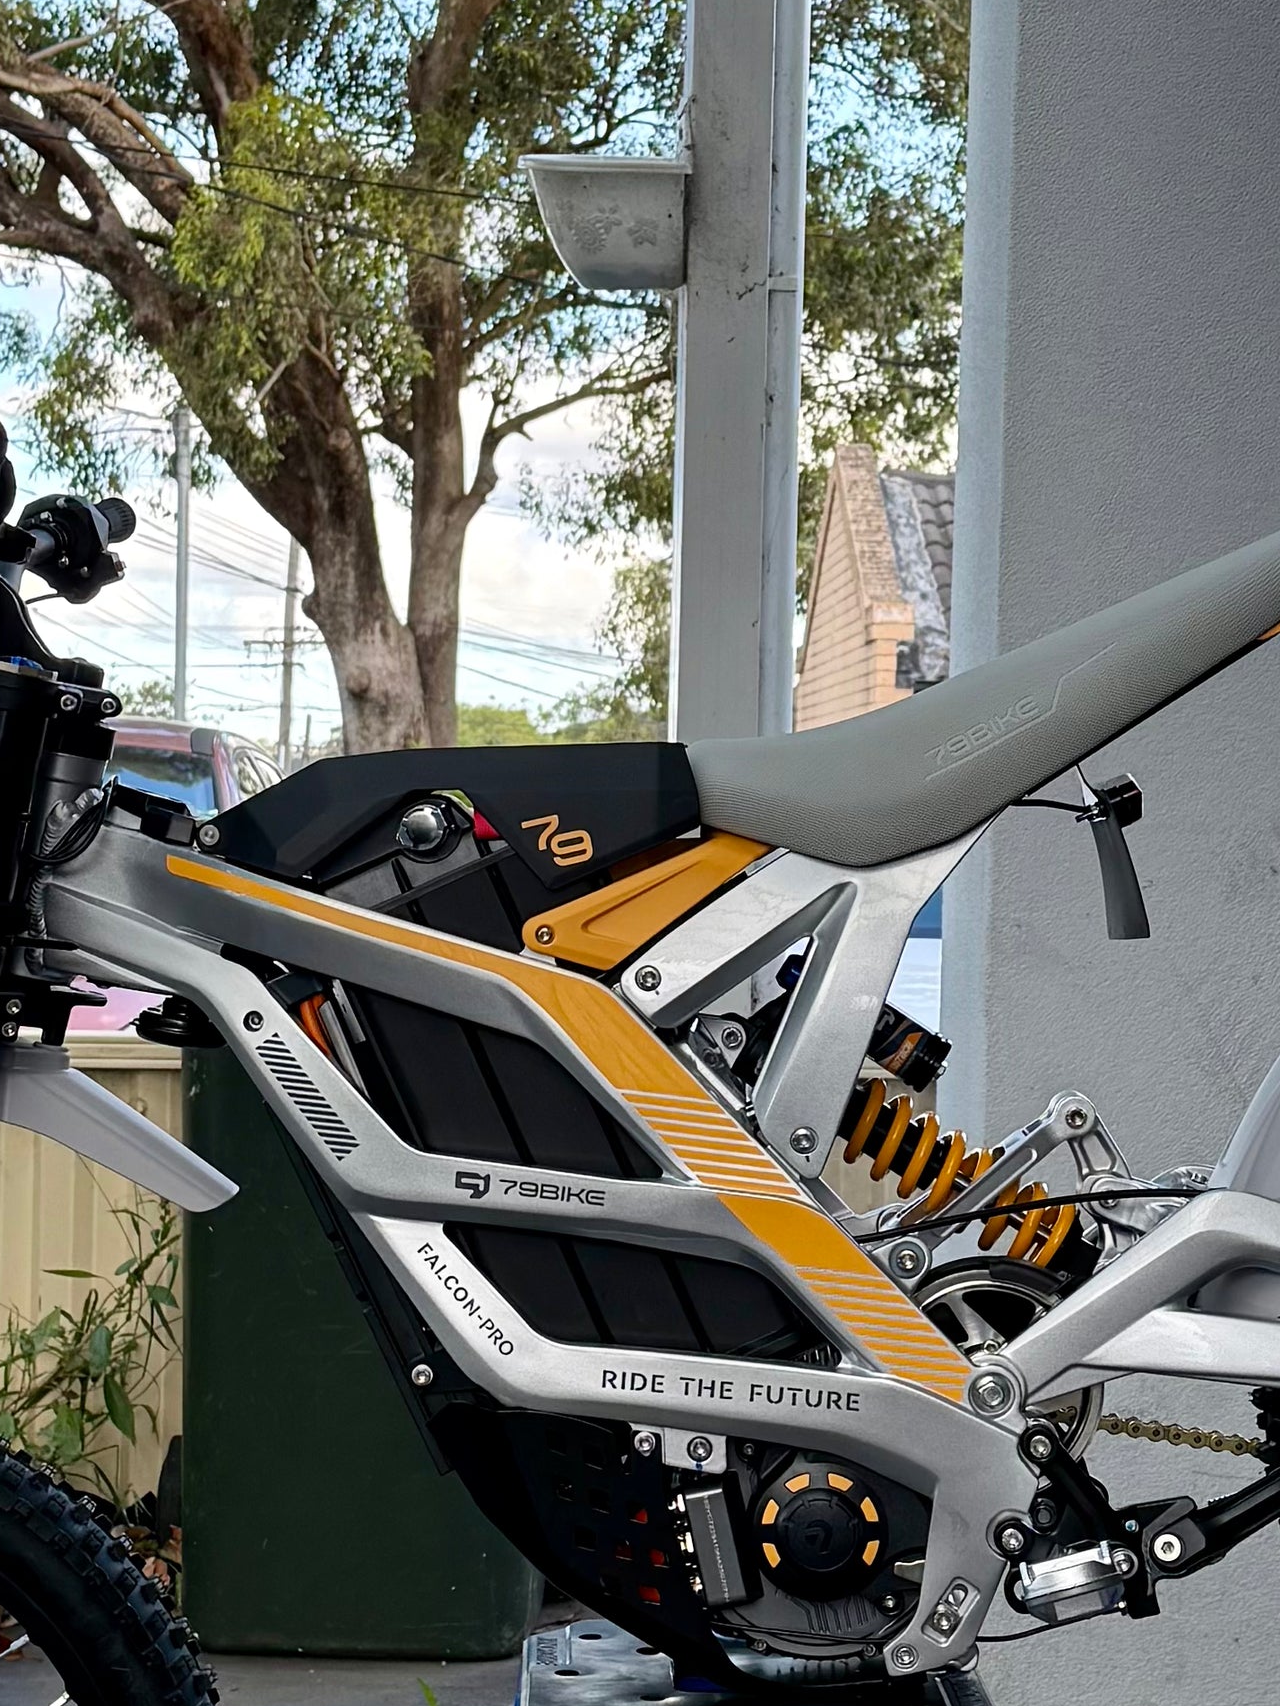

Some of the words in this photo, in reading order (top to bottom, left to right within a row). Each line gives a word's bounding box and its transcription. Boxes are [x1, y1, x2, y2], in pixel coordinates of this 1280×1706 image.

[924, 694, 1040, 765] 79BIKE
[521, 814, 594, 866] 79
[498, 1179, 607, 1207] 79BIKE
[417, 1242, 514, 1356] FALCON-PRO
[601, 1369, 665, 1394] RIDE
[679, 1377, 734, 1400] THE
[749, 1383, 861, 1412] FUTURE
